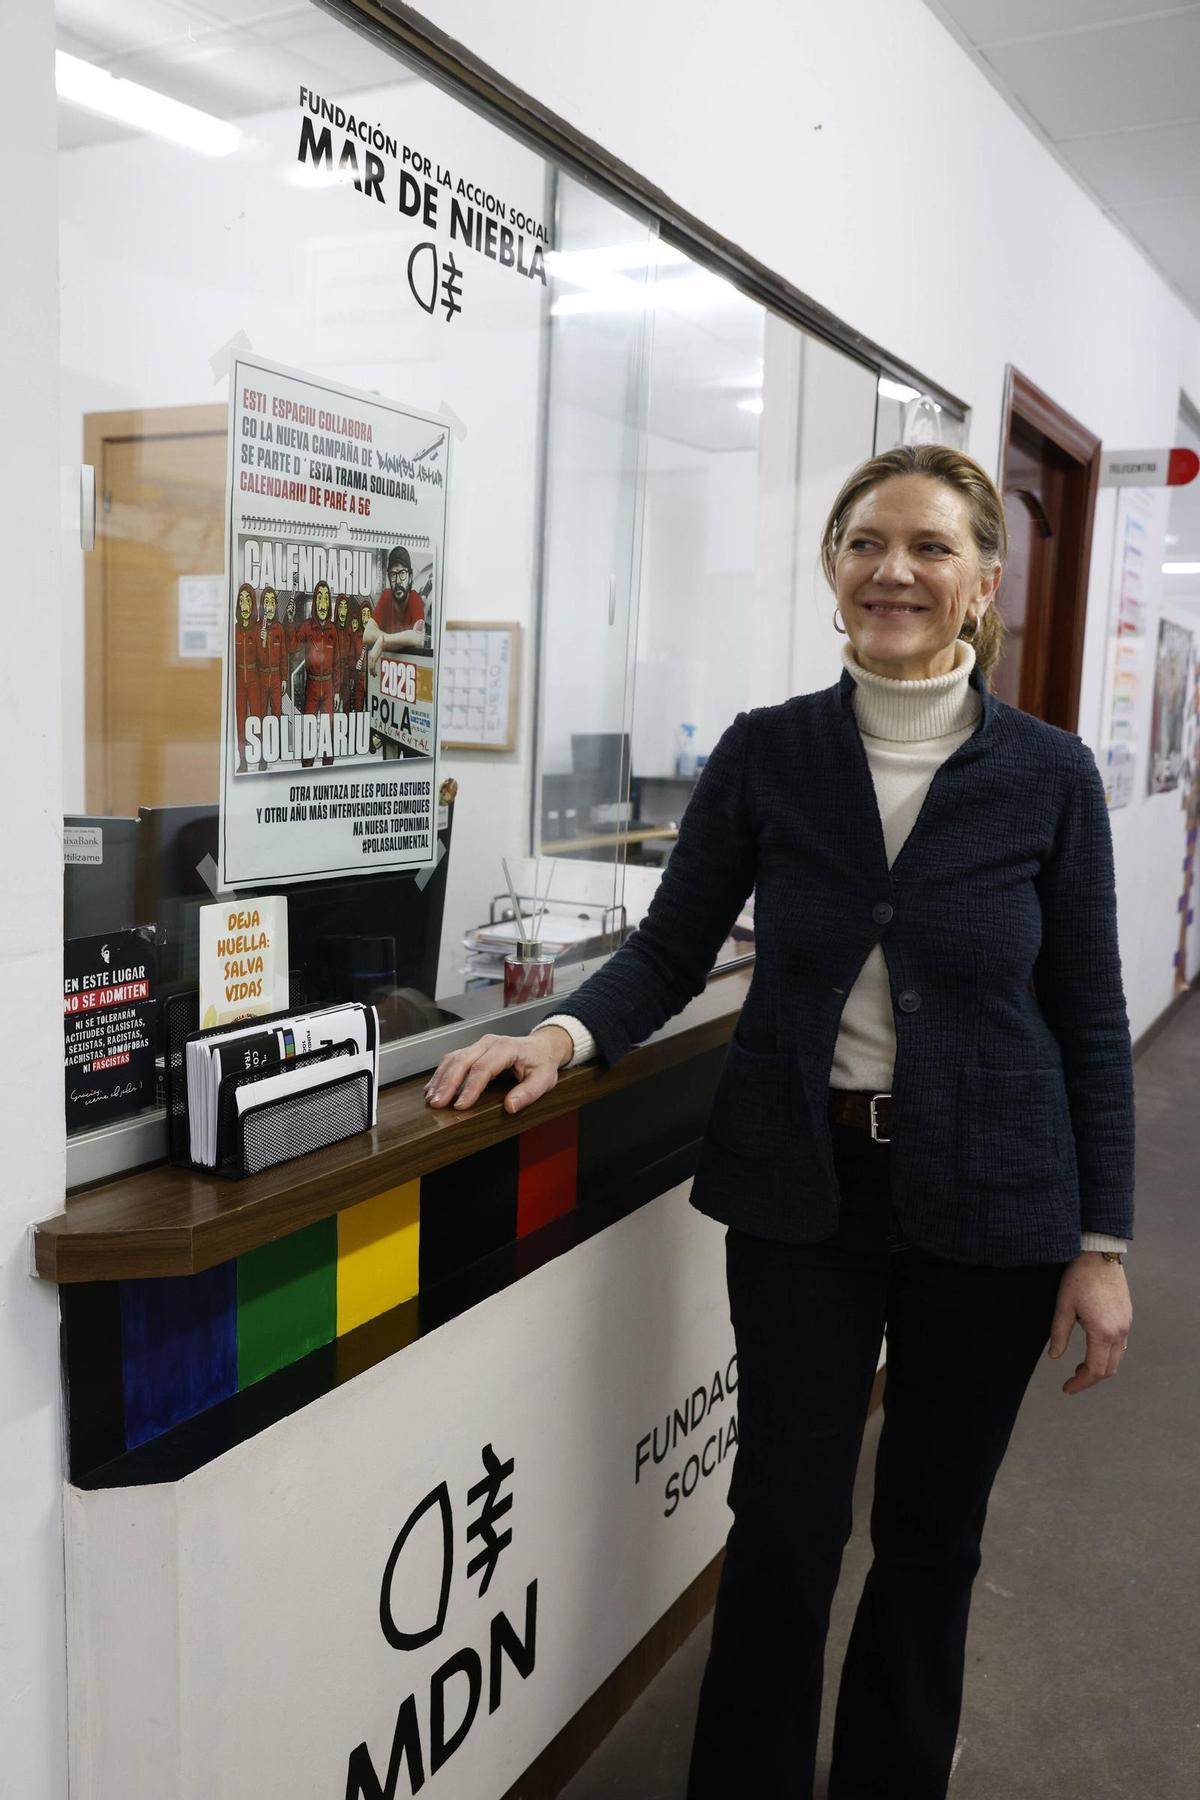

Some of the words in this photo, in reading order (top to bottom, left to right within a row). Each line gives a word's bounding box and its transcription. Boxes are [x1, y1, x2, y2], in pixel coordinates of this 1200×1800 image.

[300, 85, 397, 159] FUNDACIÓN
[402, 145, 431, 178] POR
[437, 165, 452, 190] LA
[456, 178, 505, 220] ACCION
[510, 208, 549, 245] SOCIAL
[298, 115, 386, 204] MAR
[399, 169, 438, 230] DE
[450, 198, 547, 286] NIEBLA
[243, 388, 267, 414] ESTI
[272, 396, 316, 427] ESPACIU
[319, 410, 373, 443] COLLABORA
[242, 416, 257, 438] CO
[260, 420, 273, 443] LA
[276, 424, 309, 452] NUEVA
[312, 434, 359, 463] CAMPAÑA
[361, 449, 373, 468] DE
[241, 443, 254, 466] SE
[257, 447, 291, 474] PARTE
[309, 460, 333, 483] ESTA
[335, 466, 368, 491] TRAMA
[370, 475, 418, 505] SOLIDARIA,
[240, 470, 307, 503] CALENDARIU
[309, 487, 321, 507] DE
[324, 490, 347, 512] PARÉ
[350, 495, 356, 513] A
[358, 496, 371, 516] 5€
[244, 539, 373, 597] CALENDARIU
[381, 660, 416, 703] 2026
[371, 695, 412, 735] POLA
[245, 711, 371, 764] SOLIDARIU
[289, 785, 311, 802] OTRA
[312, 784, 348, 801] XUNTAZA
[350, 783, 360, 799] DE
[361, 783, 374, 799] LES
[375, 782, 398, 798] POLES
[399, 781, 430, 797] ASTURES
[256, 808, 262, 824] Y
[264, 807, 288, 824] OTRU
[290, 803, 307, 822] AÑU
[309, 803, 328, 821] MÁS
[329, 801, 392, 820] INTERVENCIONES
[393, 799, 430, 816] COMIQUES
[353, 821, 363, 836] NA
[364, 819, 388, 836] NUESA
[390, 817, 429, 834] TOPONIMIA
[362, 834, 429, 854] #POLASALUMENTAL
[228, 910, 260, 932] DEJA
[217, 932, 270, 957] HUELLA:
[65, 977, 79, 993] EN
[83, 972, 109, 991] ESTE
[112, 965, 146, 984] LUGAR
[224, 956, 264, 981] SALVA
[64, 996, 79, 1012] NO
[82, 993, 96, 1009] SE
[99, 982, 147, 1005] ADMITEN
[225, 978, 262, 1003] VIDAS
[65, 1026, 105, 1044] ACTITUDES
[106, 1018, 146, 1035] CLASISTAS,
[75, 1019, 84, 1030] NI
[85, 1017, 95, 1028] SE
[96, 1008, 136, 1026] TOLERARÁN
[68, 1038, 106, 1055] SEXISTAS,
[107, 1029, 143, 1046] RACISTAS,
[107, 1038, 149, 1056] HOMÓFOBAS
[83, 1063, 91, 1074] NI
[92, 1053, 130, 1071] FASCISTAS
[635, 1353, 739, 1485] FUNDAC
[664, 1415, 739, 1518] SOCIA
[345, 1577, 538, 1800] MDN
